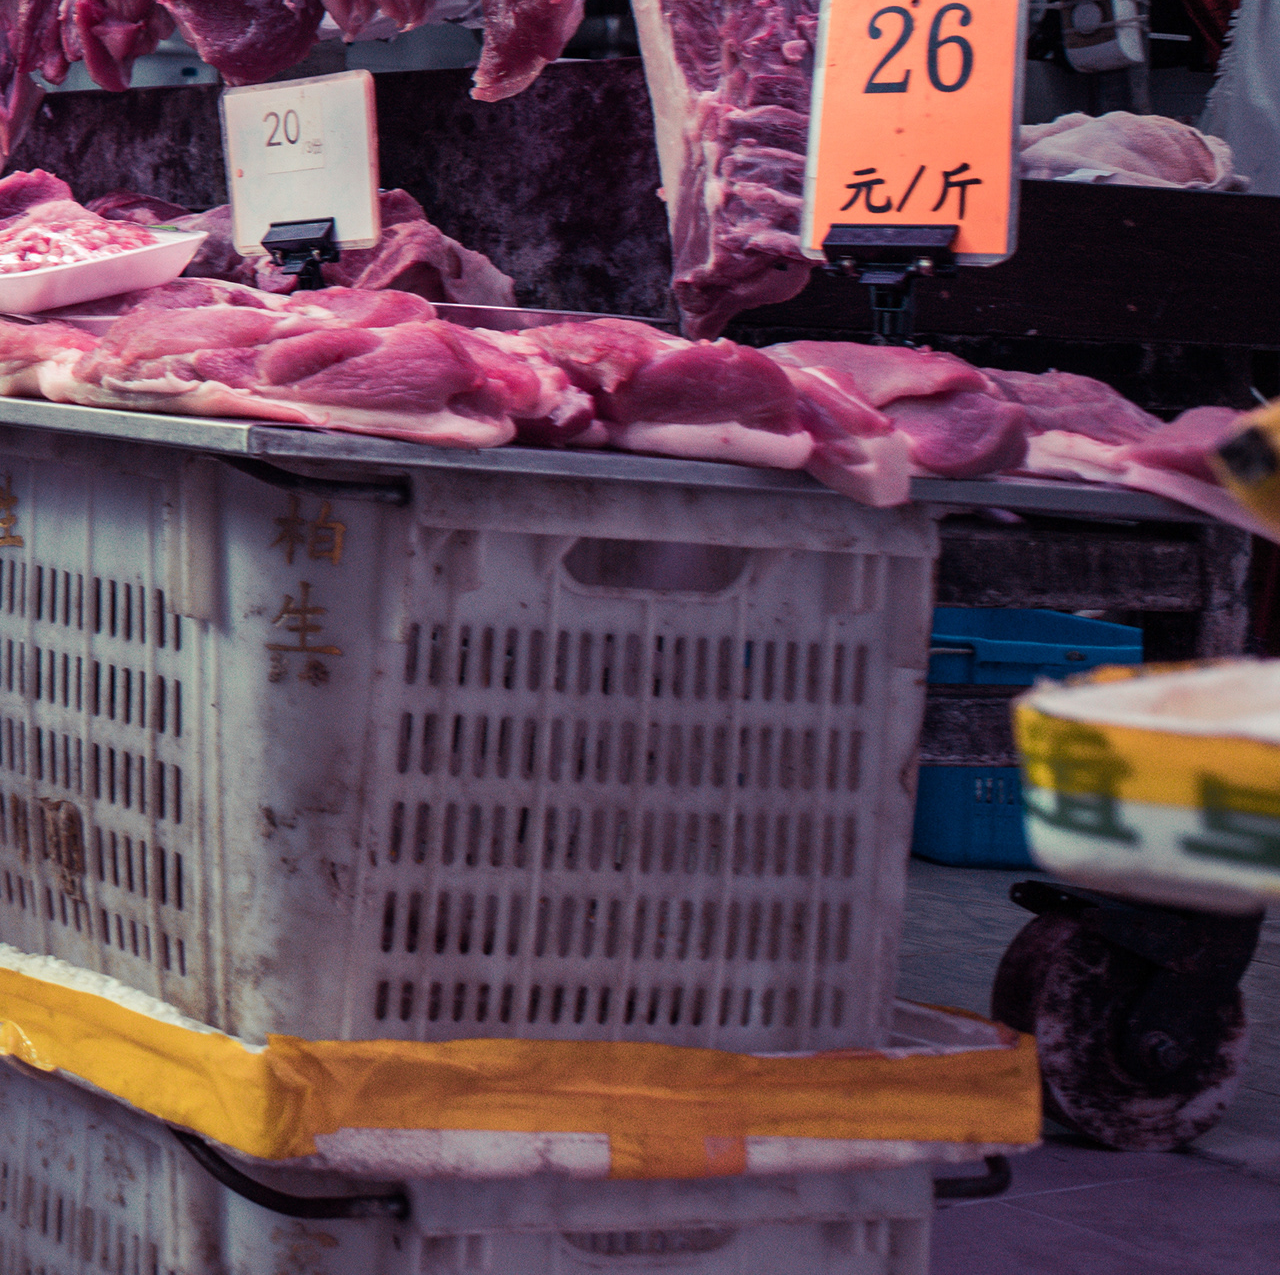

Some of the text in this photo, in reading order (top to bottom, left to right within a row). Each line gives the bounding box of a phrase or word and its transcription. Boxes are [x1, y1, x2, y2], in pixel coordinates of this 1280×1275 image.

[863, 2, 974, 94] 26
[263, 109, 300, 147] 20
[840, 162, 984, 220] 元/斤
